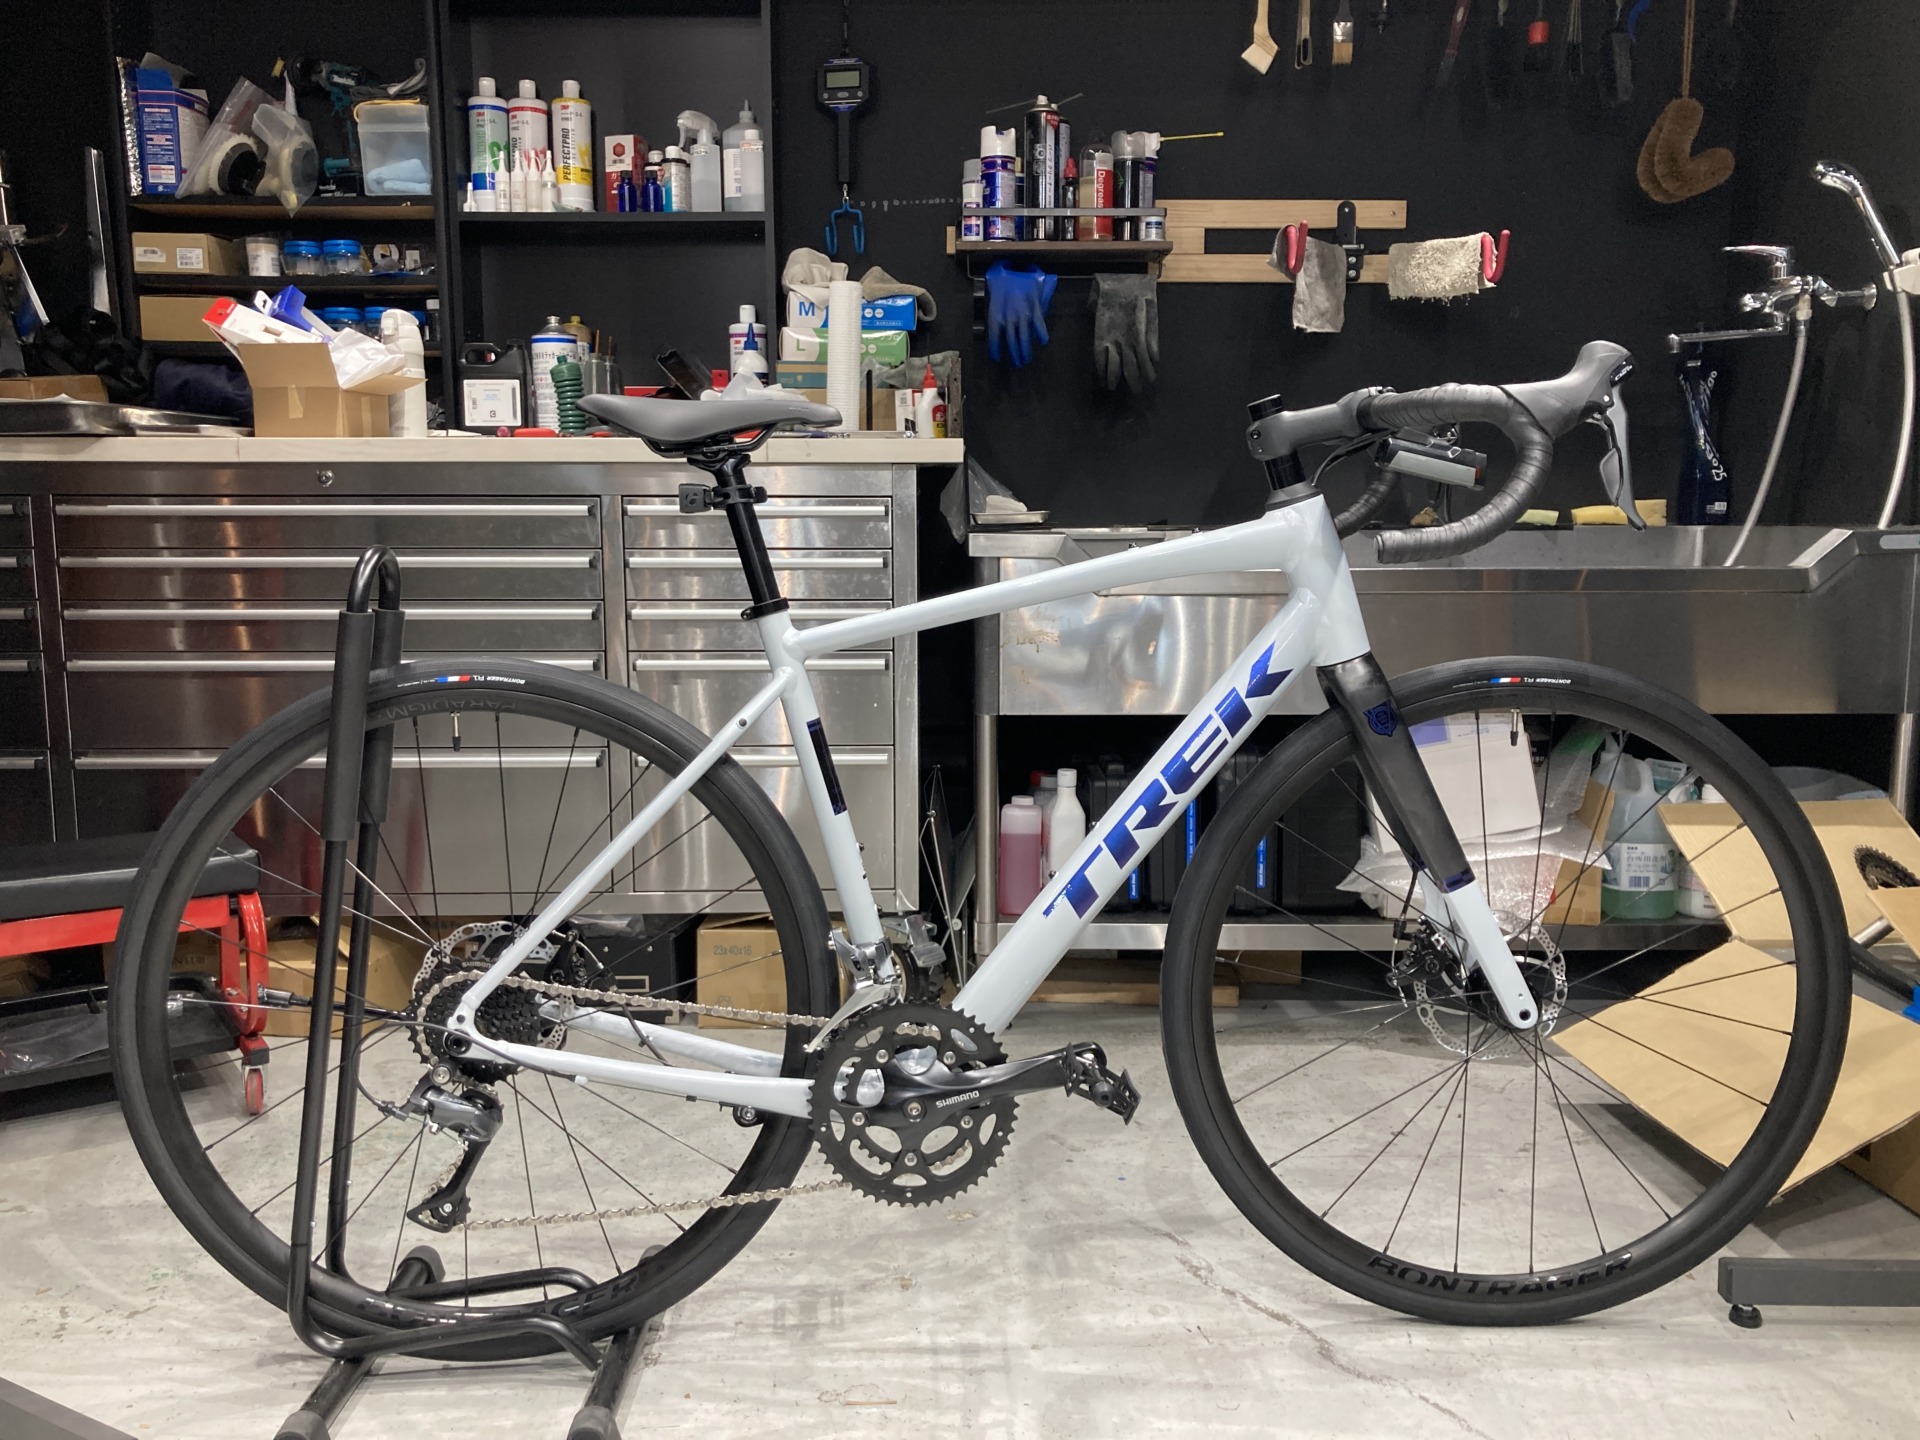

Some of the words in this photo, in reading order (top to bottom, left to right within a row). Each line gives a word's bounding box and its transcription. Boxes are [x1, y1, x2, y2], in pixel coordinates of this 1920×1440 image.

[561, 128, 571, 181] PERFECTPRO
[1096, 171, 1106, 208] Degreas
[798, 301, 816, 317] M
[795, 338, 806, 352] L
[486, 675, 526, 685] BONTRAGER
[1043, 640, 1294, 919] TREK
[713, 944, 753, 957] 23x40x16
[935, 1090, 980, 1109] SHIMANO
[1366, 1251, 1633, 1296] BONTRAGER
